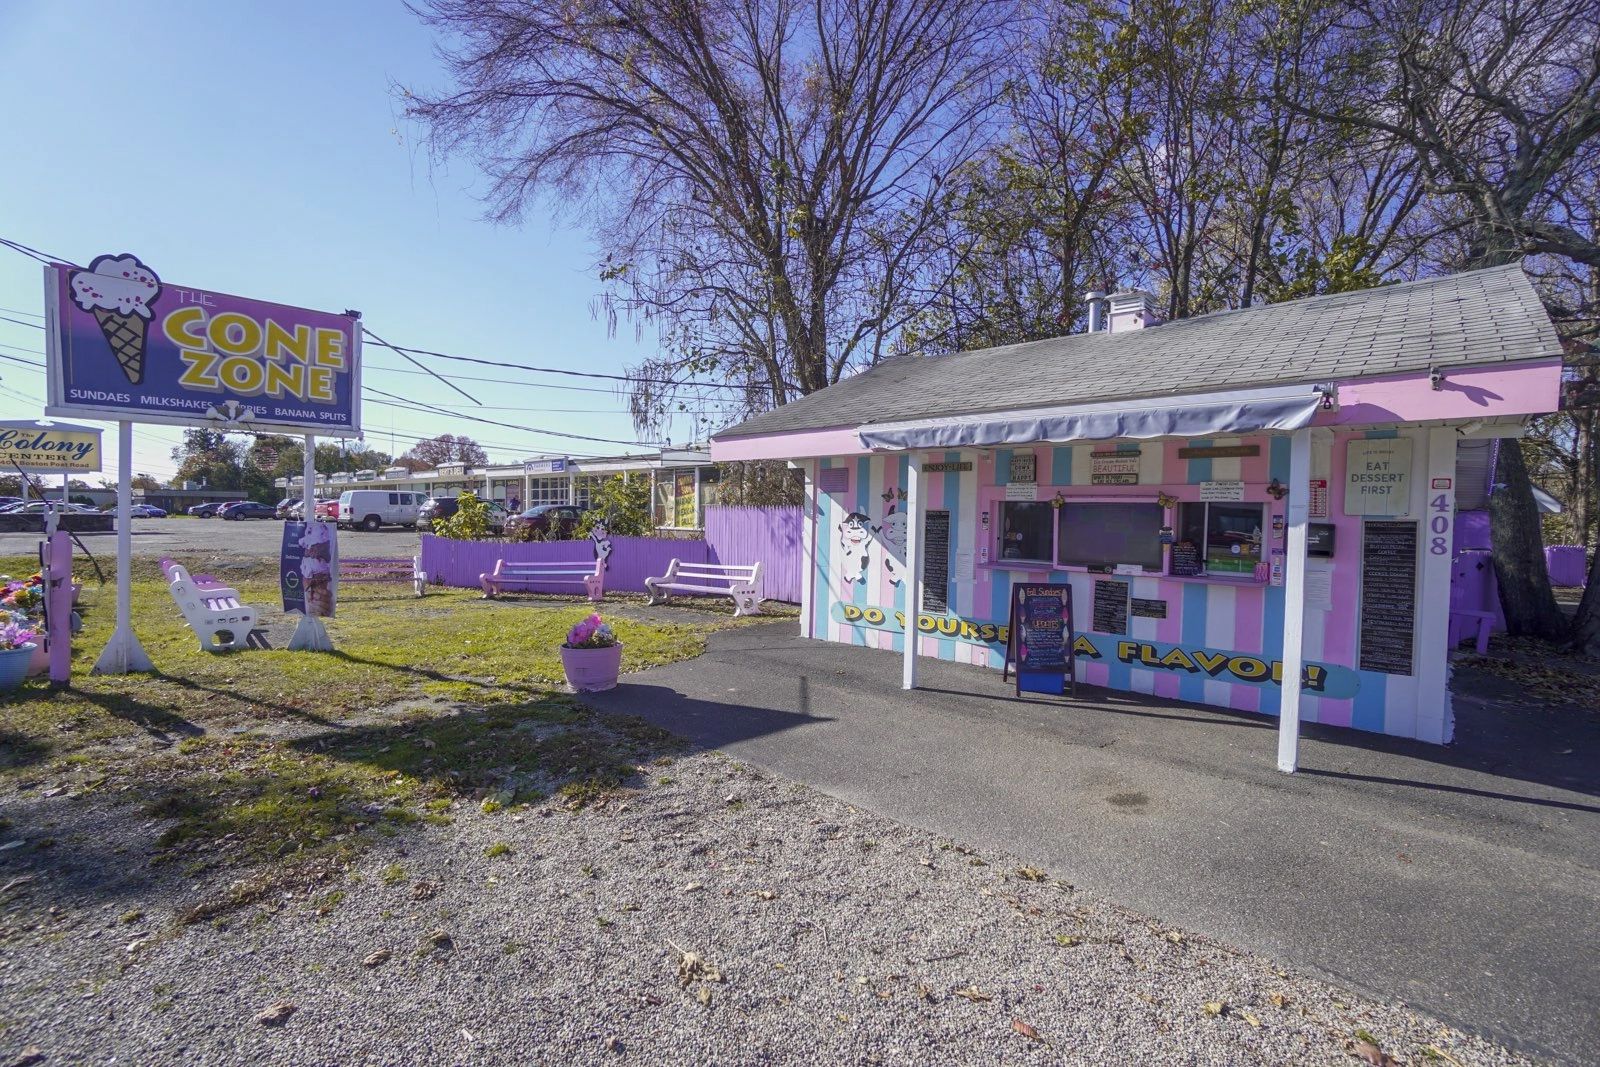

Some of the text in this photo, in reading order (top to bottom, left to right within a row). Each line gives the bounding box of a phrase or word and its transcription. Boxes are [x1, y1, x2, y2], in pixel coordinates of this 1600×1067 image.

[176, 289, 216, 307] THE
[162, 306, 346, 370] CONE
[178, 349, 335, 401] ZONE
[70, 389, 131, 403] SUNDAES
[140, 395, 213, 410] MILKSHAKES
[274, 407, 316, 419] BANANA
[319, 411, 347, 421] SPLITS
[0, 430, 94, 460] Colony
[0, 452, 68, 461] CENTER
[1093, 464, 1136, 473] BEAUTIFUL
[1351, 473, 1405, 483] DESSERT
[1366, 461, 1389, 471] EAT
[1361, 485, 1392, 495] FIRST
[1430, 494, 1450, 555] 408
[844, 604, 886, 626] DO
[1073, 634, 1102, 659] A
